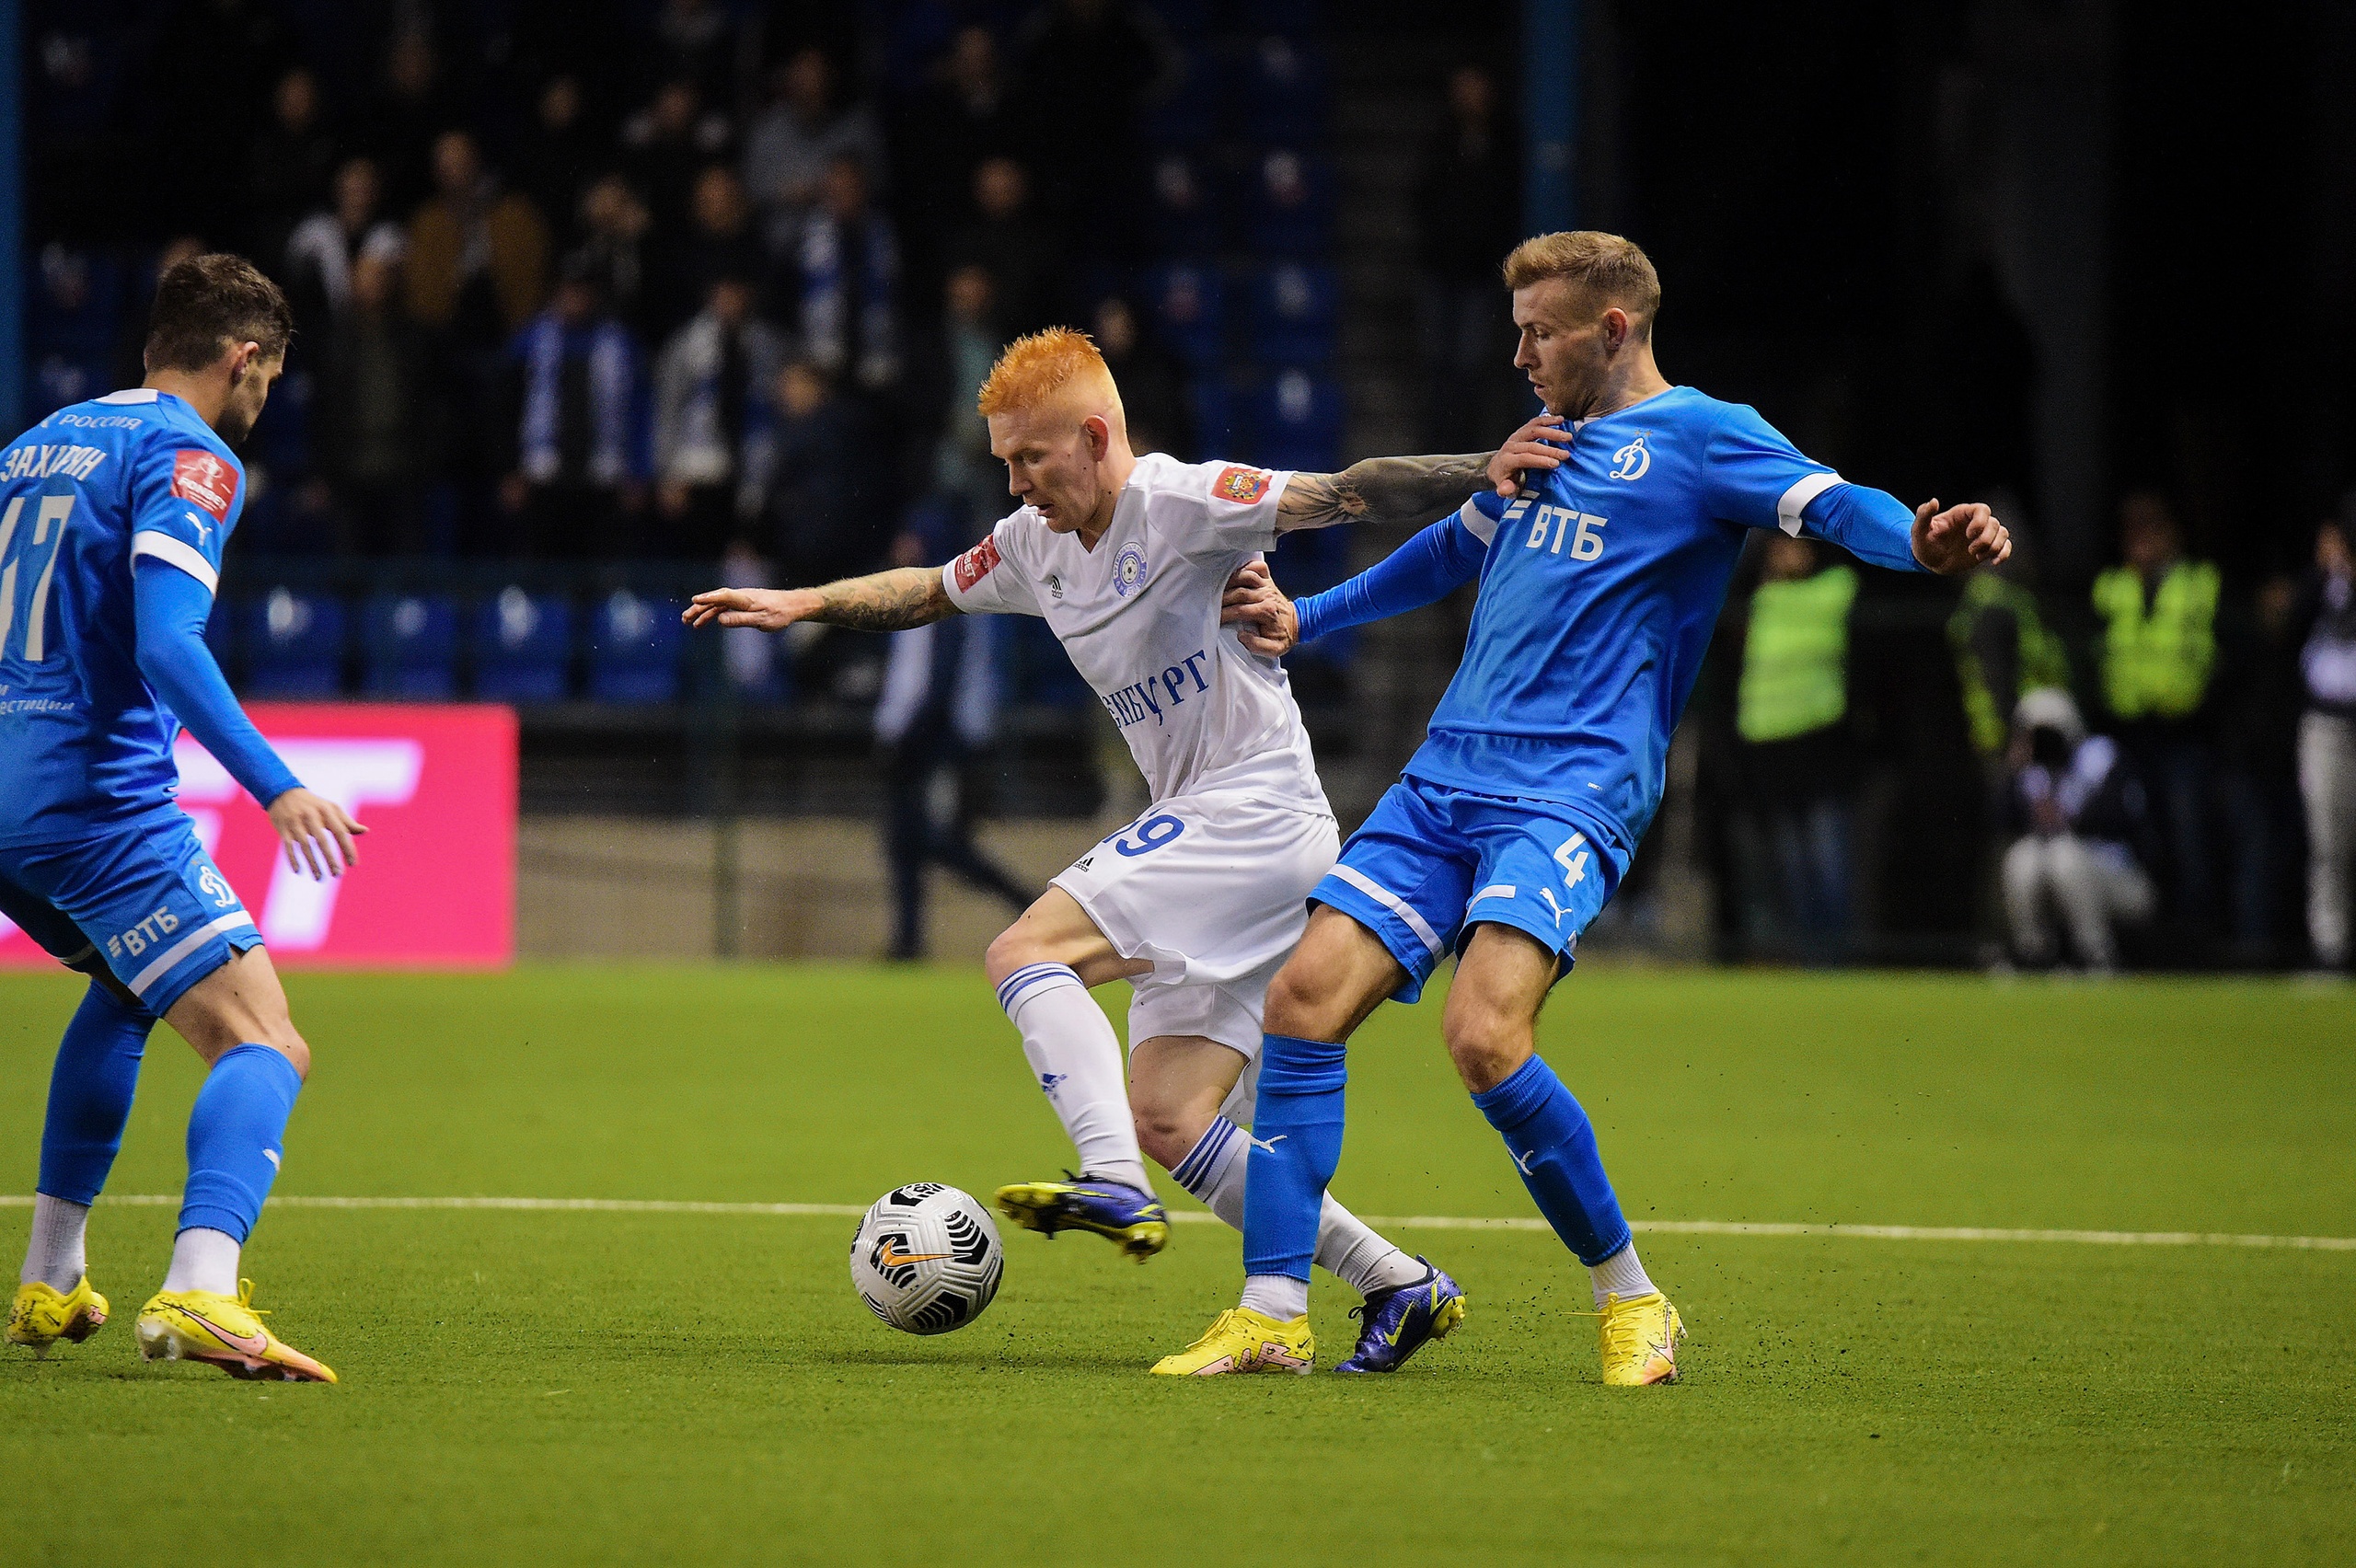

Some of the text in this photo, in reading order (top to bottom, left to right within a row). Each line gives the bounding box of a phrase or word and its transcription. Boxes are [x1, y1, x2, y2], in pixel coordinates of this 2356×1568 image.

[58, 413, 144, 431] РОССИЯ
[1526, 503, 1609, 562] ВТБ
[0, 698, 75, 716] естиции
[1553, 831, 1589, 890] 4
[121, 905, 179, 957] ВТБ
